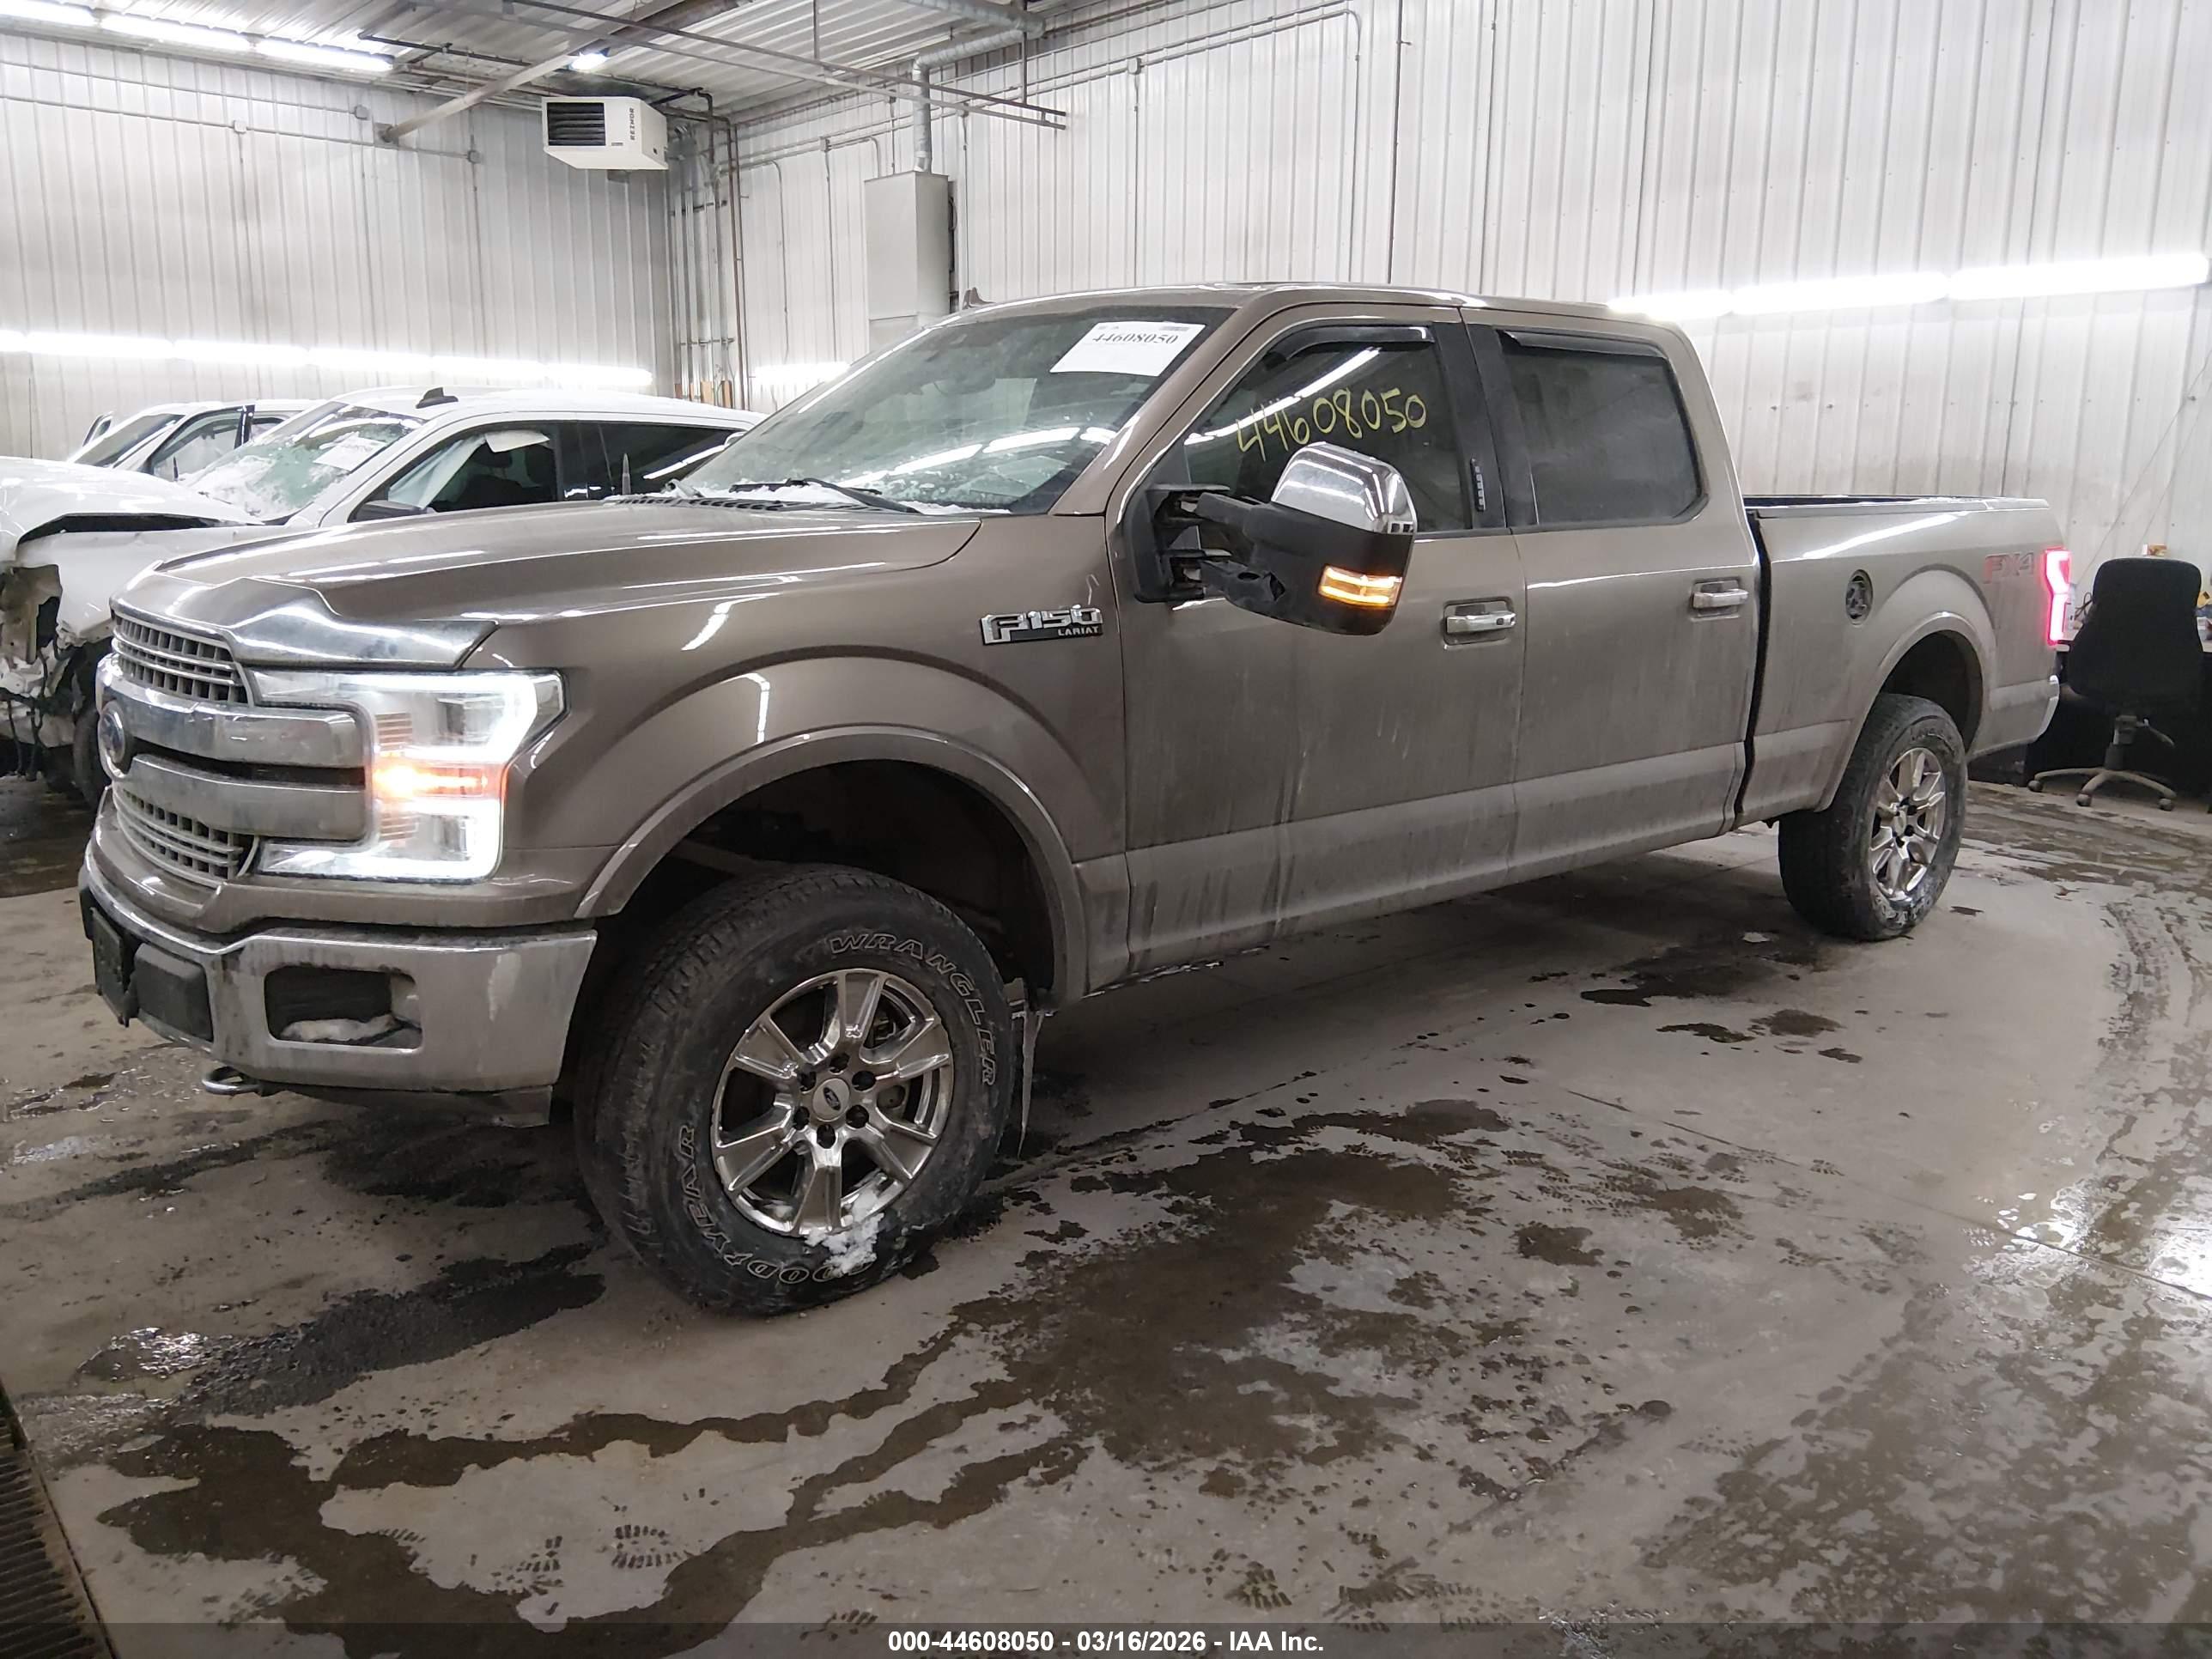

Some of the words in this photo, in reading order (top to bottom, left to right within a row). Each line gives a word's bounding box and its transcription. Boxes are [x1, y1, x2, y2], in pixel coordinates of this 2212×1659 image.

[1092, 332, 1179, 344] 44608050
[1236, 387, 1427, 462] 44608050
[1982, 552, 2034, 585] FX4
[1058, 626, 1099, 636] LARIAT
[829, 933, 996, 1086] WRANGLER
[679, 1124, 874, 1284] OODYEAR
